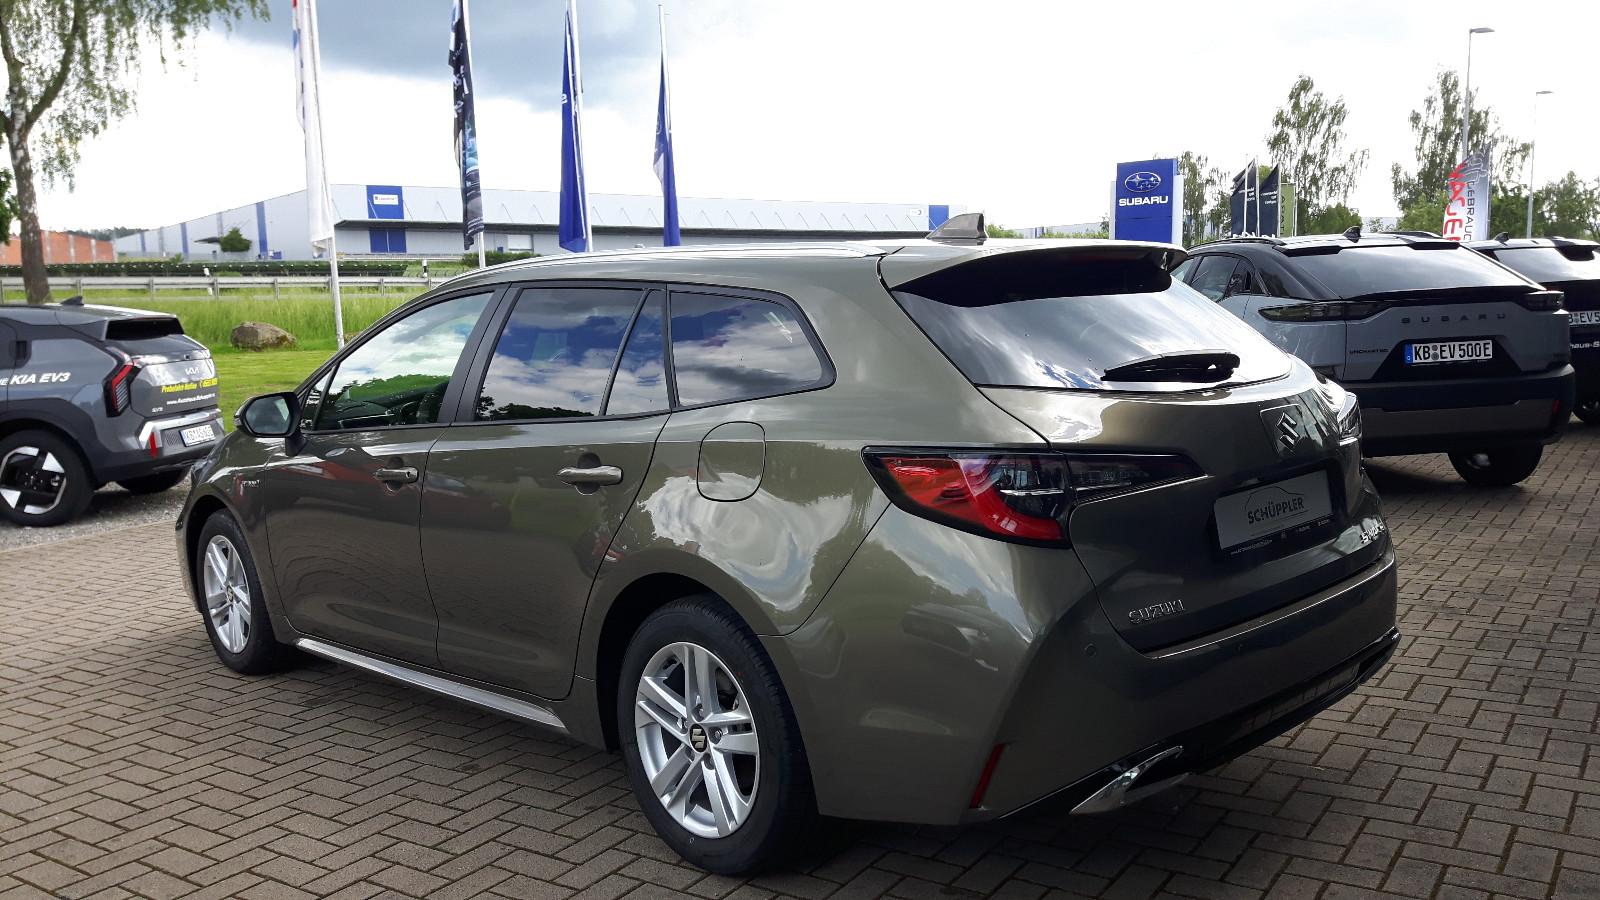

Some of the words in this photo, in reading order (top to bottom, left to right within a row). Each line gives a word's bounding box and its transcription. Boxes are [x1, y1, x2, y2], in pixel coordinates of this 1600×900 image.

[1119, 195, 1169, 207] SUBARU
[1401, 313, 1506, 324] SUBARU
[1414, 345, 1431, 361] KB
[1440, 343, 1456, 360] EV
[10, 373, 37, 385] KIA
[39, 371, 71, 383] EV3
[1247, 497, 1305, 525] SCHÜPPLER
[1128, 599, 1186, 625] SUZUKI
